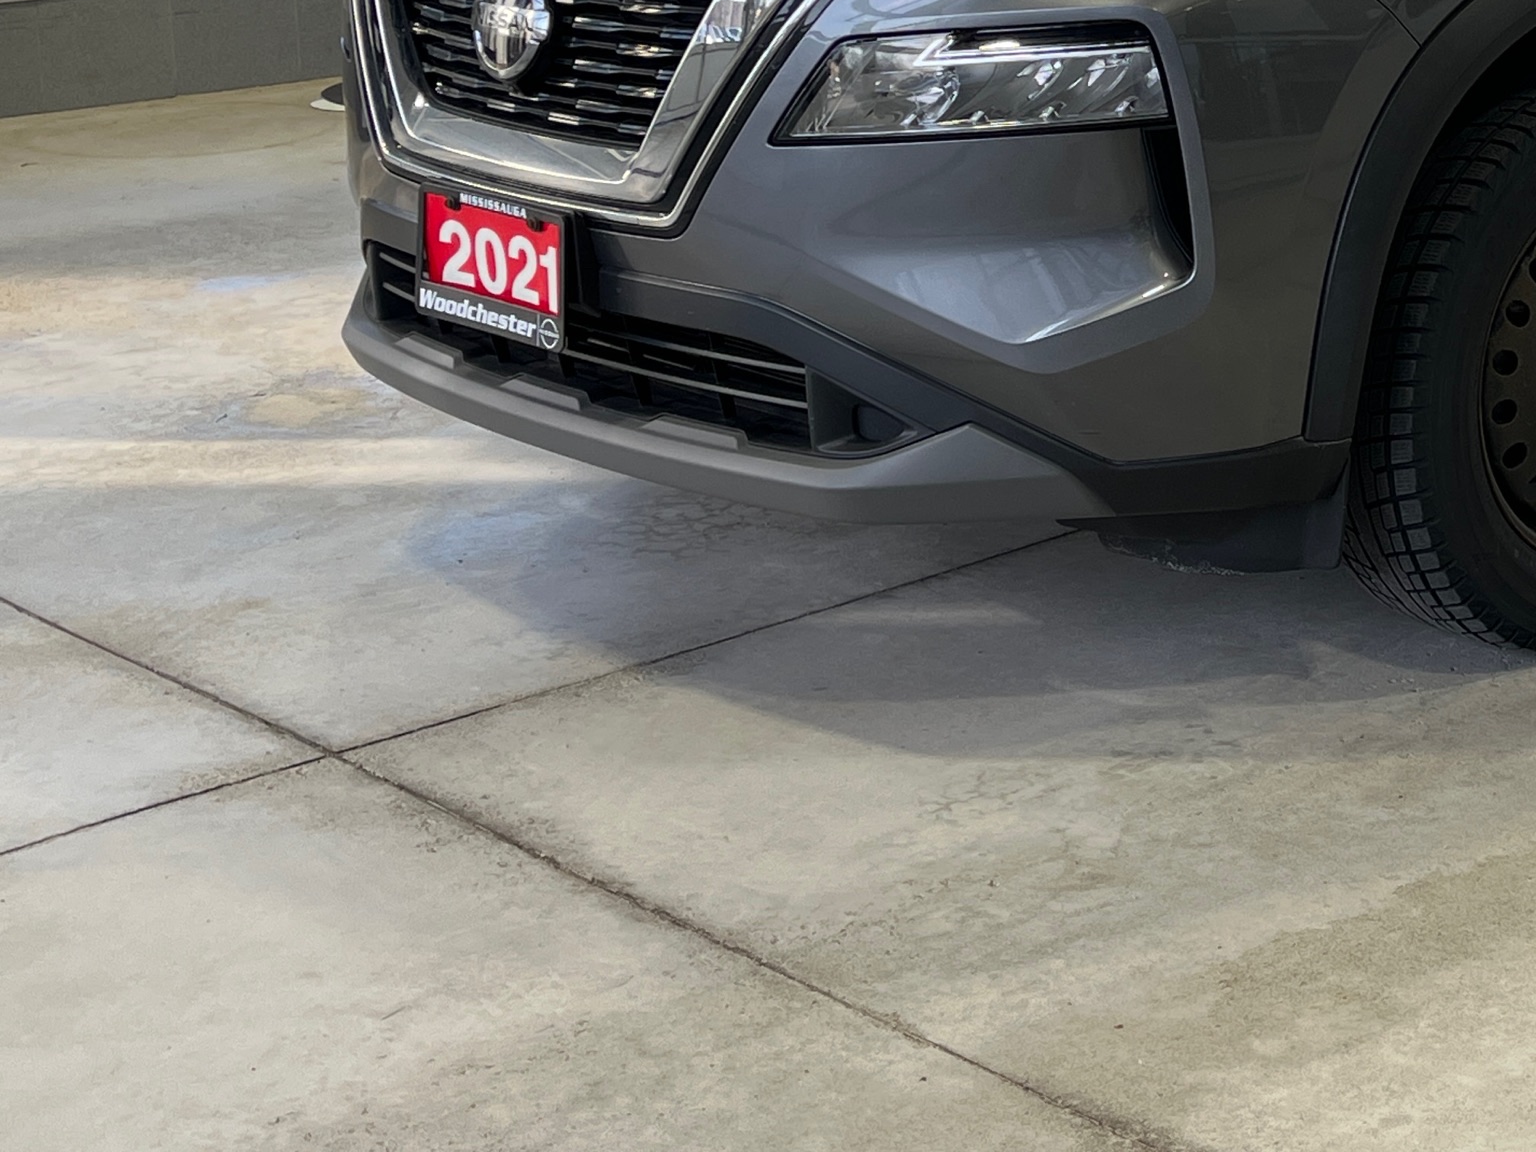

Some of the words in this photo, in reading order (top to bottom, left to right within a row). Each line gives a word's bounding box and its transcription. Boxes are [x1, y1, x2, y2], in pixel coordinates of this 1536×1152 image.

[459, 193, 527, 219] MISSISSAUGA
[438, 219, 559, 314] 2021
[418, 287, 537, 338] Woodchester
